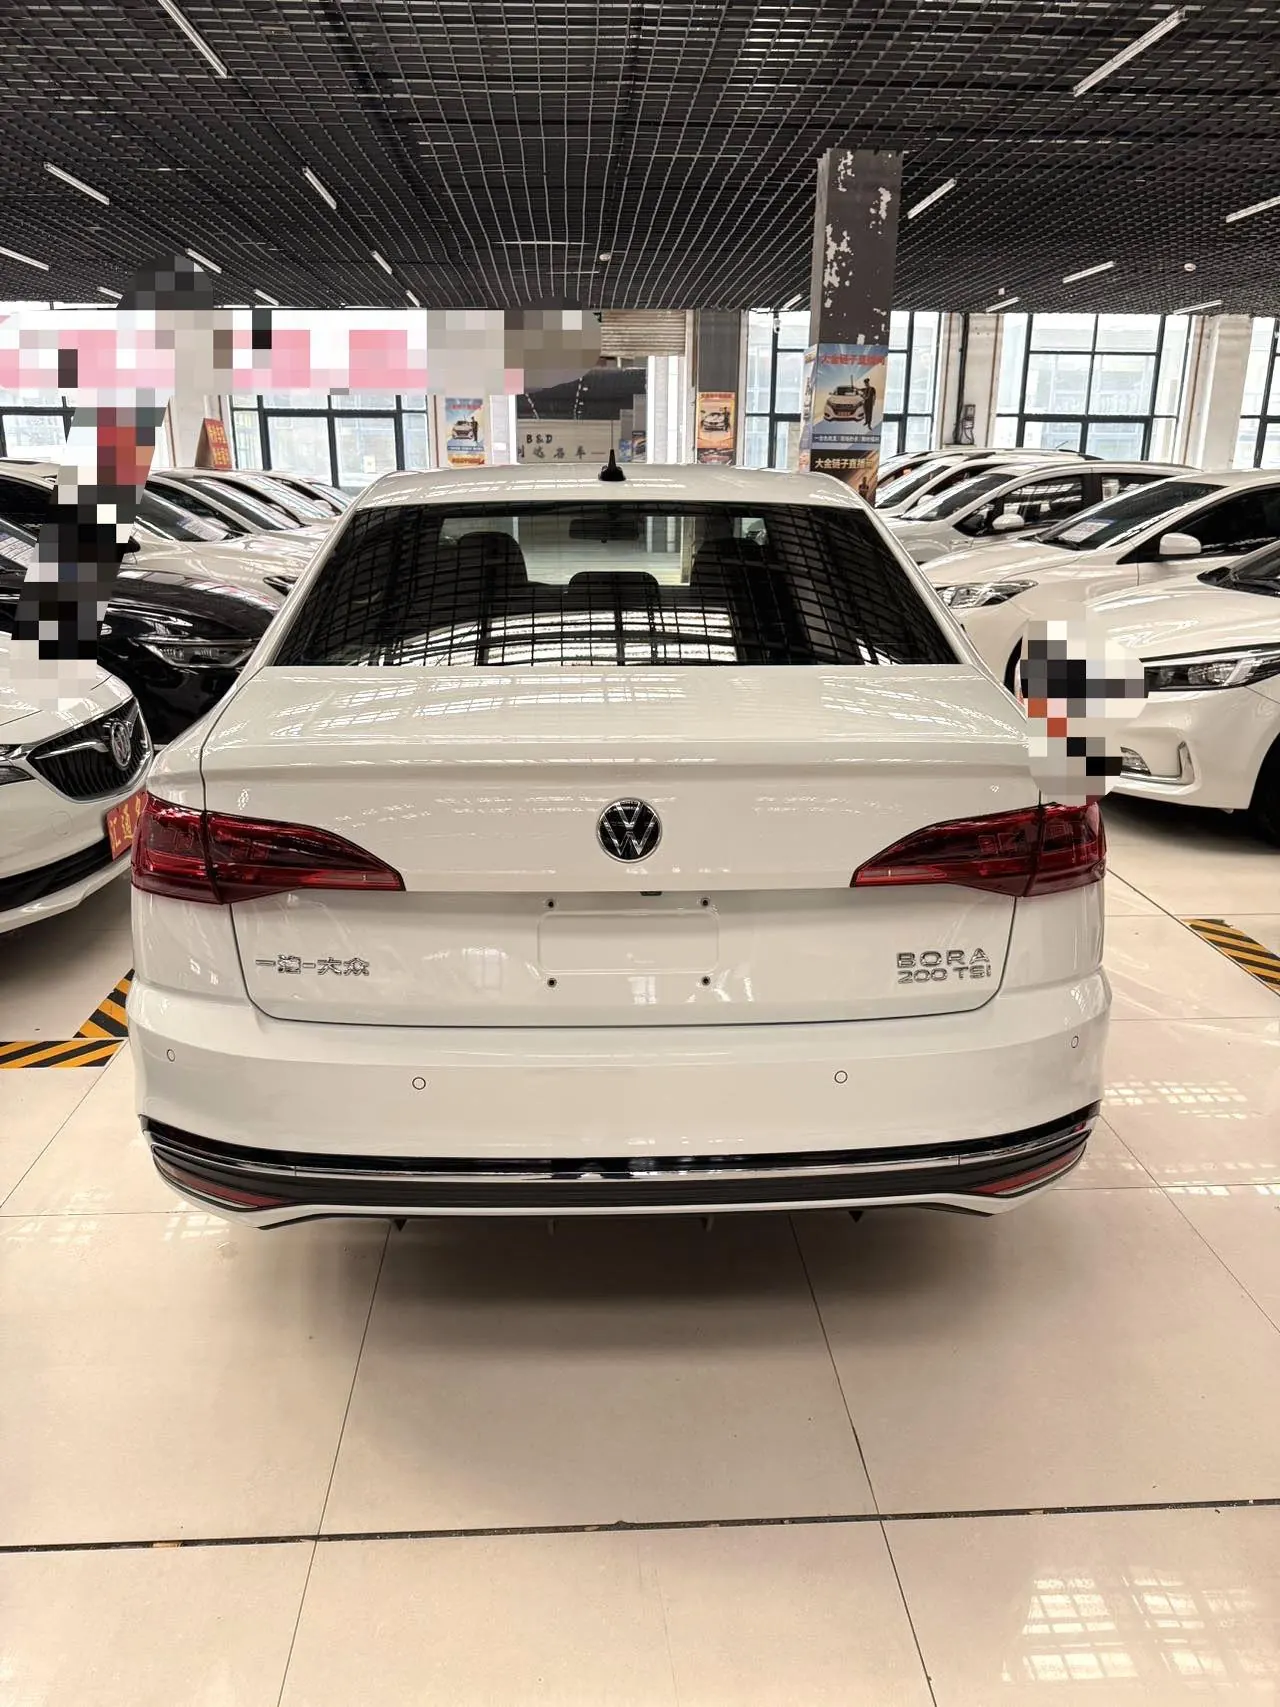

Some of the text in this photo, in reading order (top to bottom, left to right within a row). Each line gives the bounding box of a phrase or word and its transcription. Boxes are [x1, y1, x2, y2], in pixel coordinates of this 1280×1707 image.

[526, 434, 553, 444] B&D
[896, 947, 991, 968] BORA
[898, 964, 992, 984] 200 TSI
